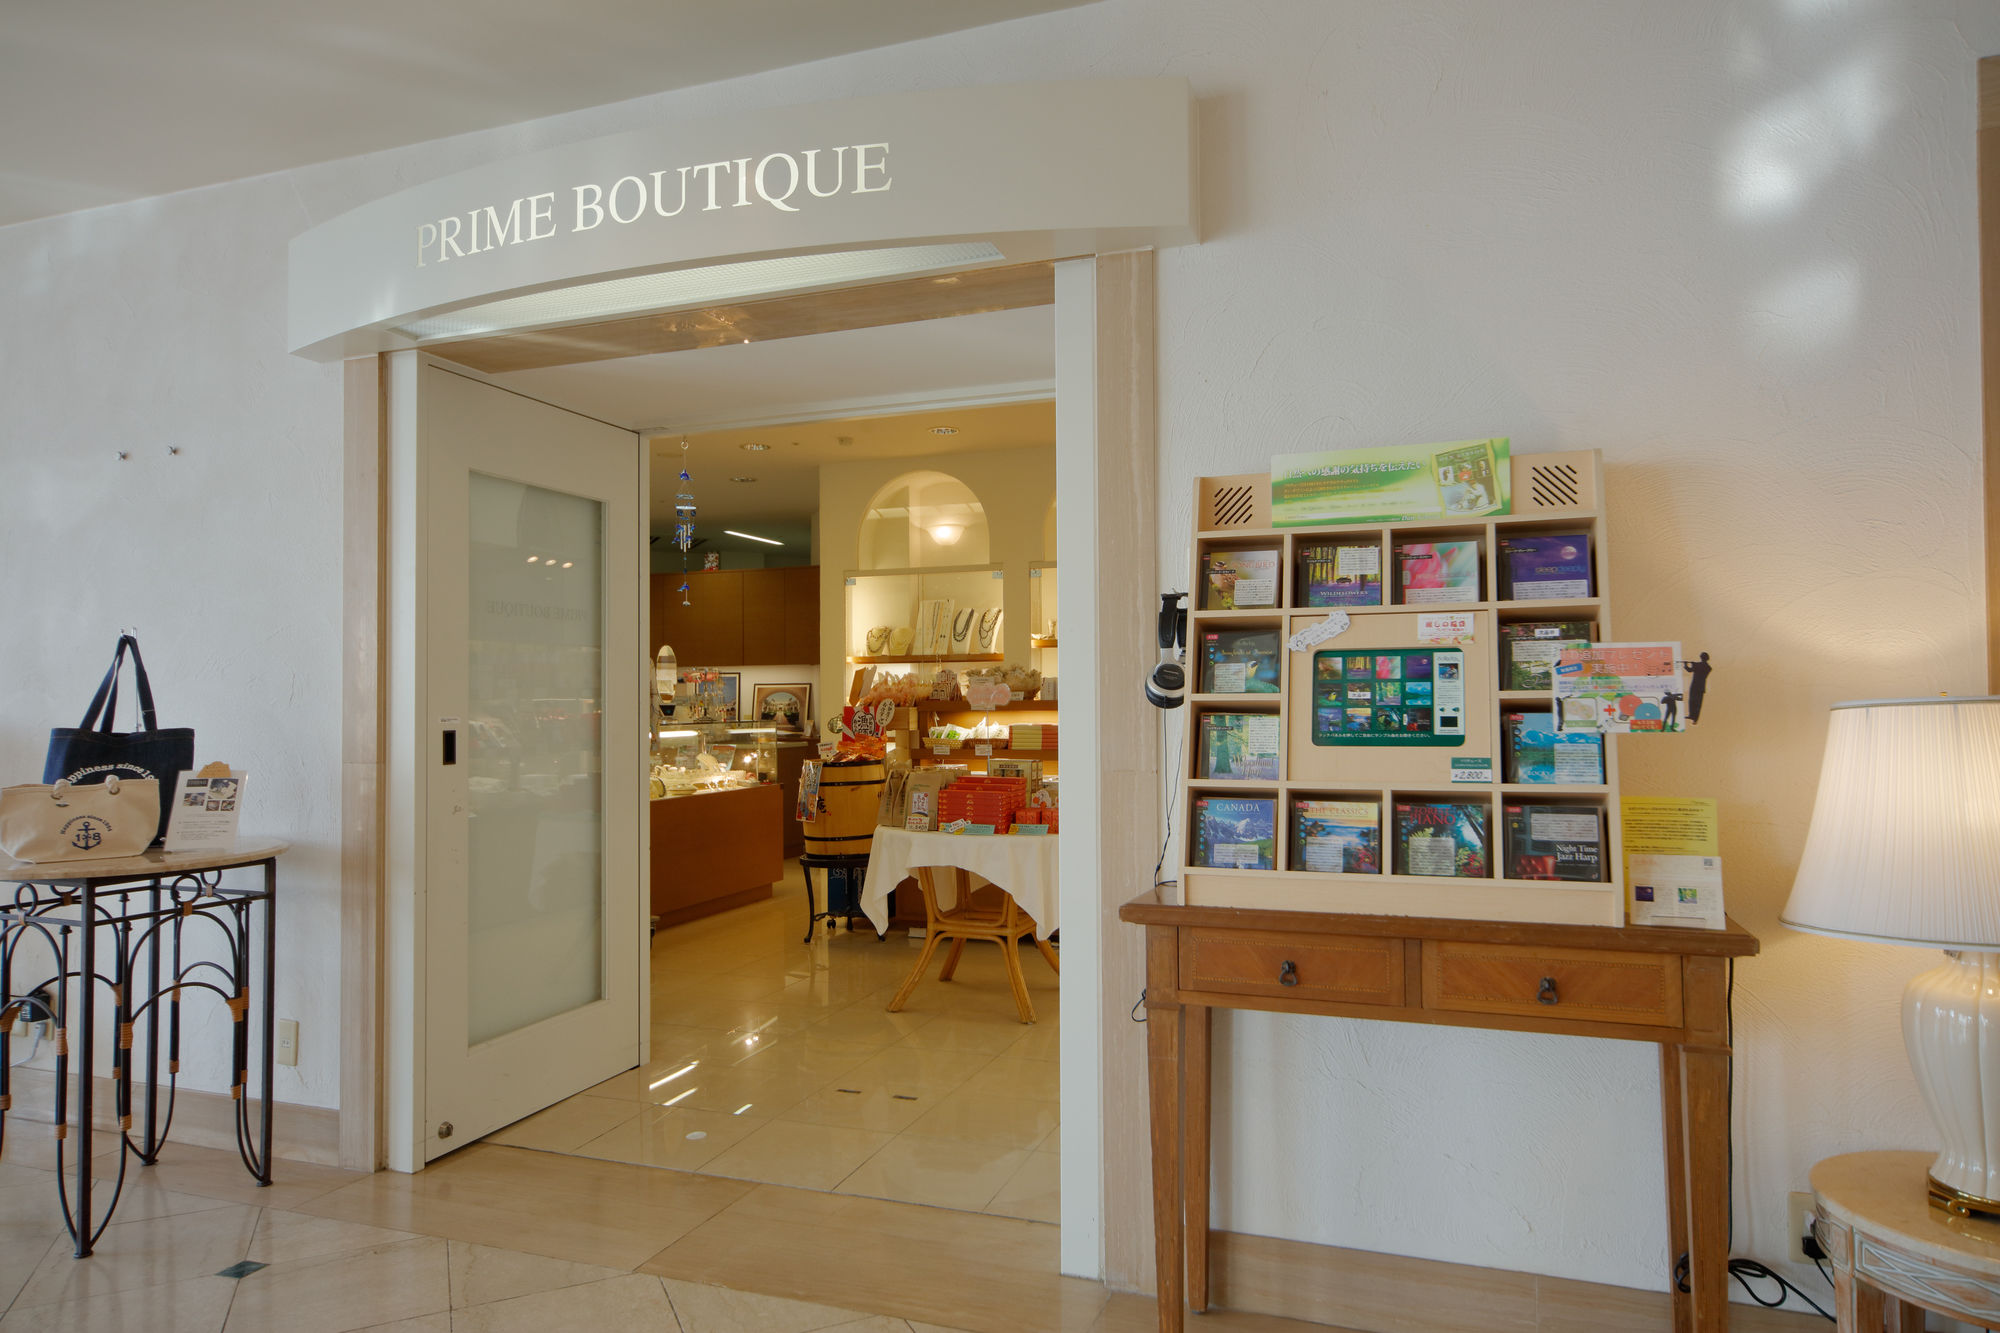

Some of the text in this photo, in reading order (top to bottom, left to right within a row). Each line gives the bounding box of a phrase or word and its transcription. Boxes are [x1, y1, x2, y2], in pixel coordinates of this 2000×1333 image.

[415, 142, 893, 268] PRIME BOUTIQUE
[116, 762, 145, 774] since
[1216, 802, 1260, 813] CANADA
[1310, 807, 1370, 816] THE CLASSICS
[1413, 806, 1451, 816] FOREST
[1408, 813, 1457, 825] PIANO
[1556, 844, 1599, 854] Night Time
[1555, 852, 1598, 864] Jazz Harp
